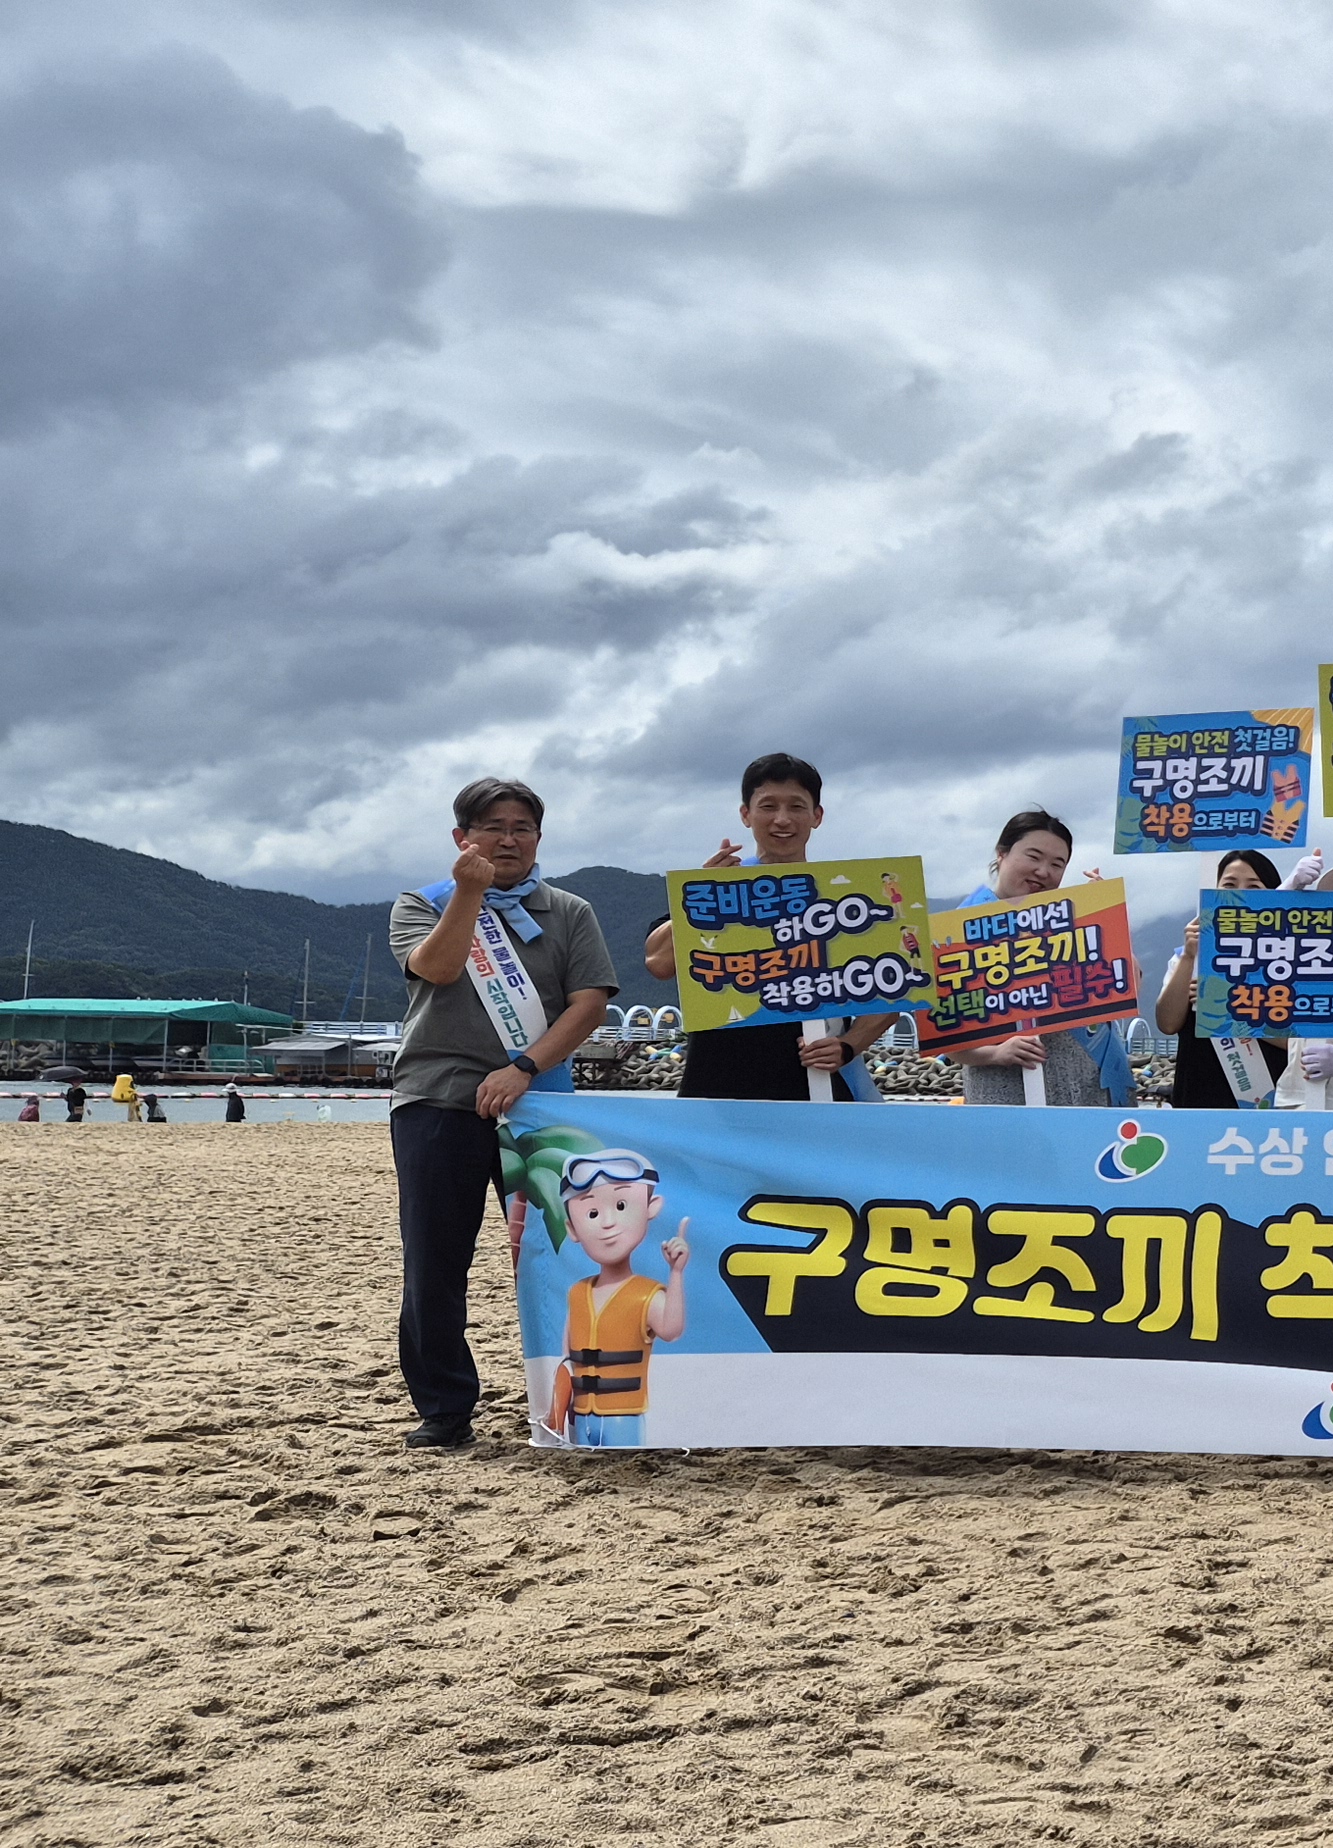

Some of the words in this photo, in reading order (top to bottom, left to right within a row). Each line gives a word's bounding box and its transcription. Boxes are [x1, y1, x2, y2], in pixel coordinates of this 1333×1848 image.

[1135, 733, 1188, 757] 물놀이
[1192, 730, 1230, 754] 안전
[1233, 726, 1296, 752] 첫걸음!
[1132, 755, 1265, 799] 구명조끼
[1143, 802, 1256, 837] 착용으로부터
[685, 877, 810, 922] 준비운동
[965, 899, 1070, 941] 바다에선
[1217, 909, 1281, 933] 물놀이
[1288, 909, 1333, 934] 안전
[478, 905, 502, 944] 전한
[692, 939, 820, 987] 구명조끼
[938, 925, 1099, 990] 구명조끼!
[487, 978, 528, 1048] 시작입니다
[930, 990, 1005, 1028] 선택이
[1008, 983, 1048, 1007] 아닌
[1052, 958, 1125, 1001] 필수!
[1207, 1127, 1304, 1176] 수상
[727, 1201, 1221, 1341] 구명조끼
